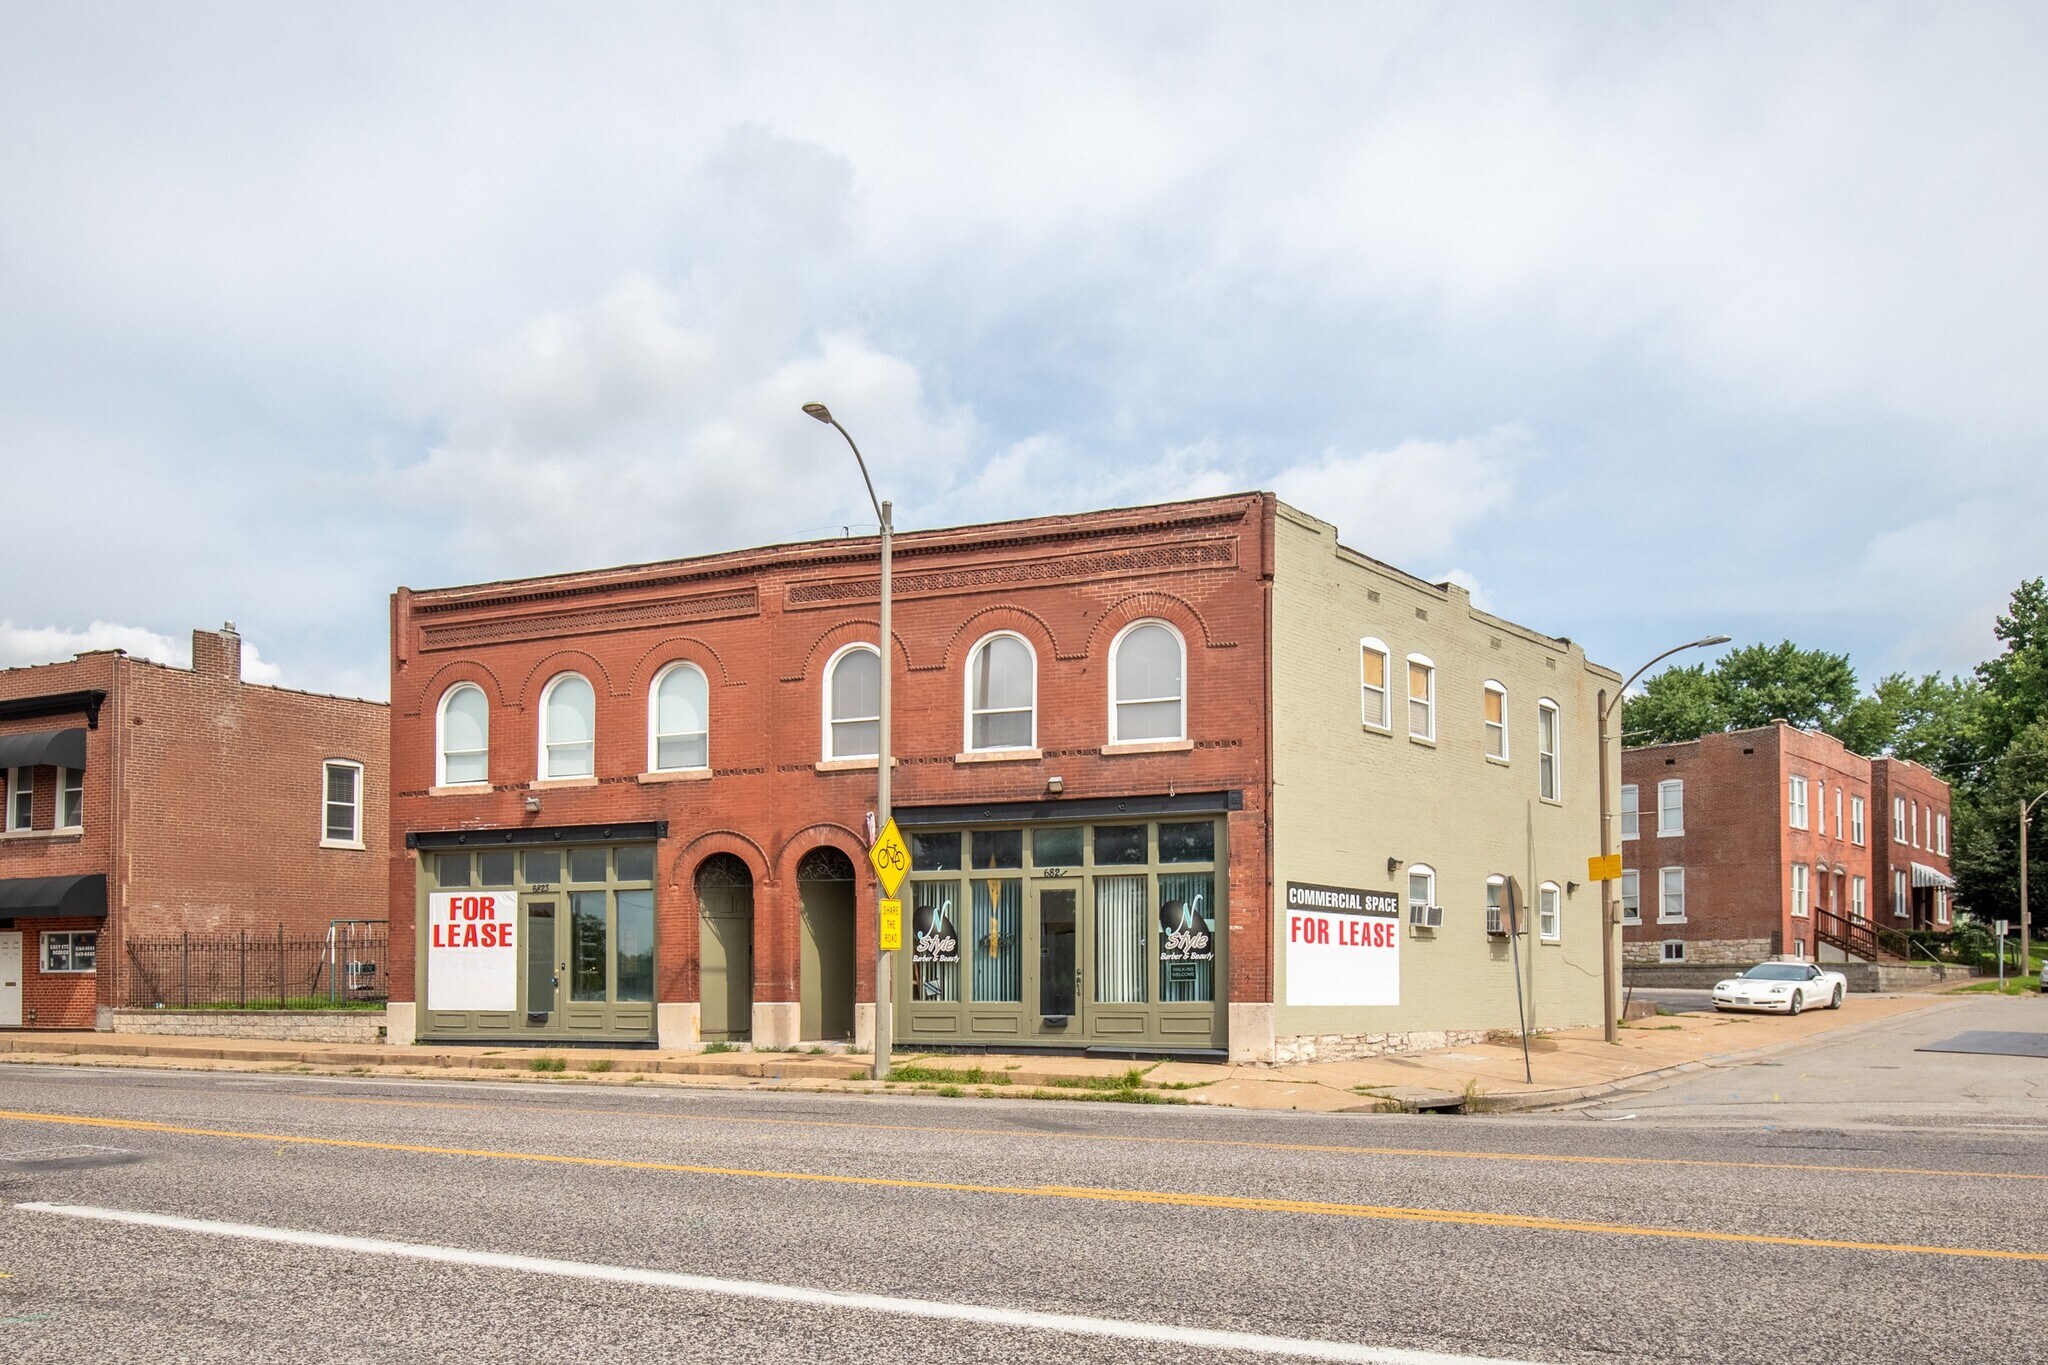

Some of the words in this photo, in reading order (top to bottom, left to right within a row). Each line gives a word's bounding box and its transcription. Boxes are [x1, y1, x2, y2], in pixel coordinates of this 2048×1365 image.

[449, 896, 495, 920] FOR
[883, 905, 899, 916] SHARE
[1289, 887, 1362, 909] COMMERCIAL
[1365, 895, 1397, 912] SPACE
[433, 923, 512, 947] LEASE
[887, 920, 896, 930] THE
[1291, 916, 1329, 944] FOR
[1339, 920, 1395, 948] LEASE
[884, 933, 897, 943] ROAD
[917, 934, 956, 956] Style
[1165, 931, 1209, 954] Style
[939, 955, 960, 963] Beauty
[1161, 952, 1182, 960] Barber
[1190, 952, 1214, 961] Beauty
